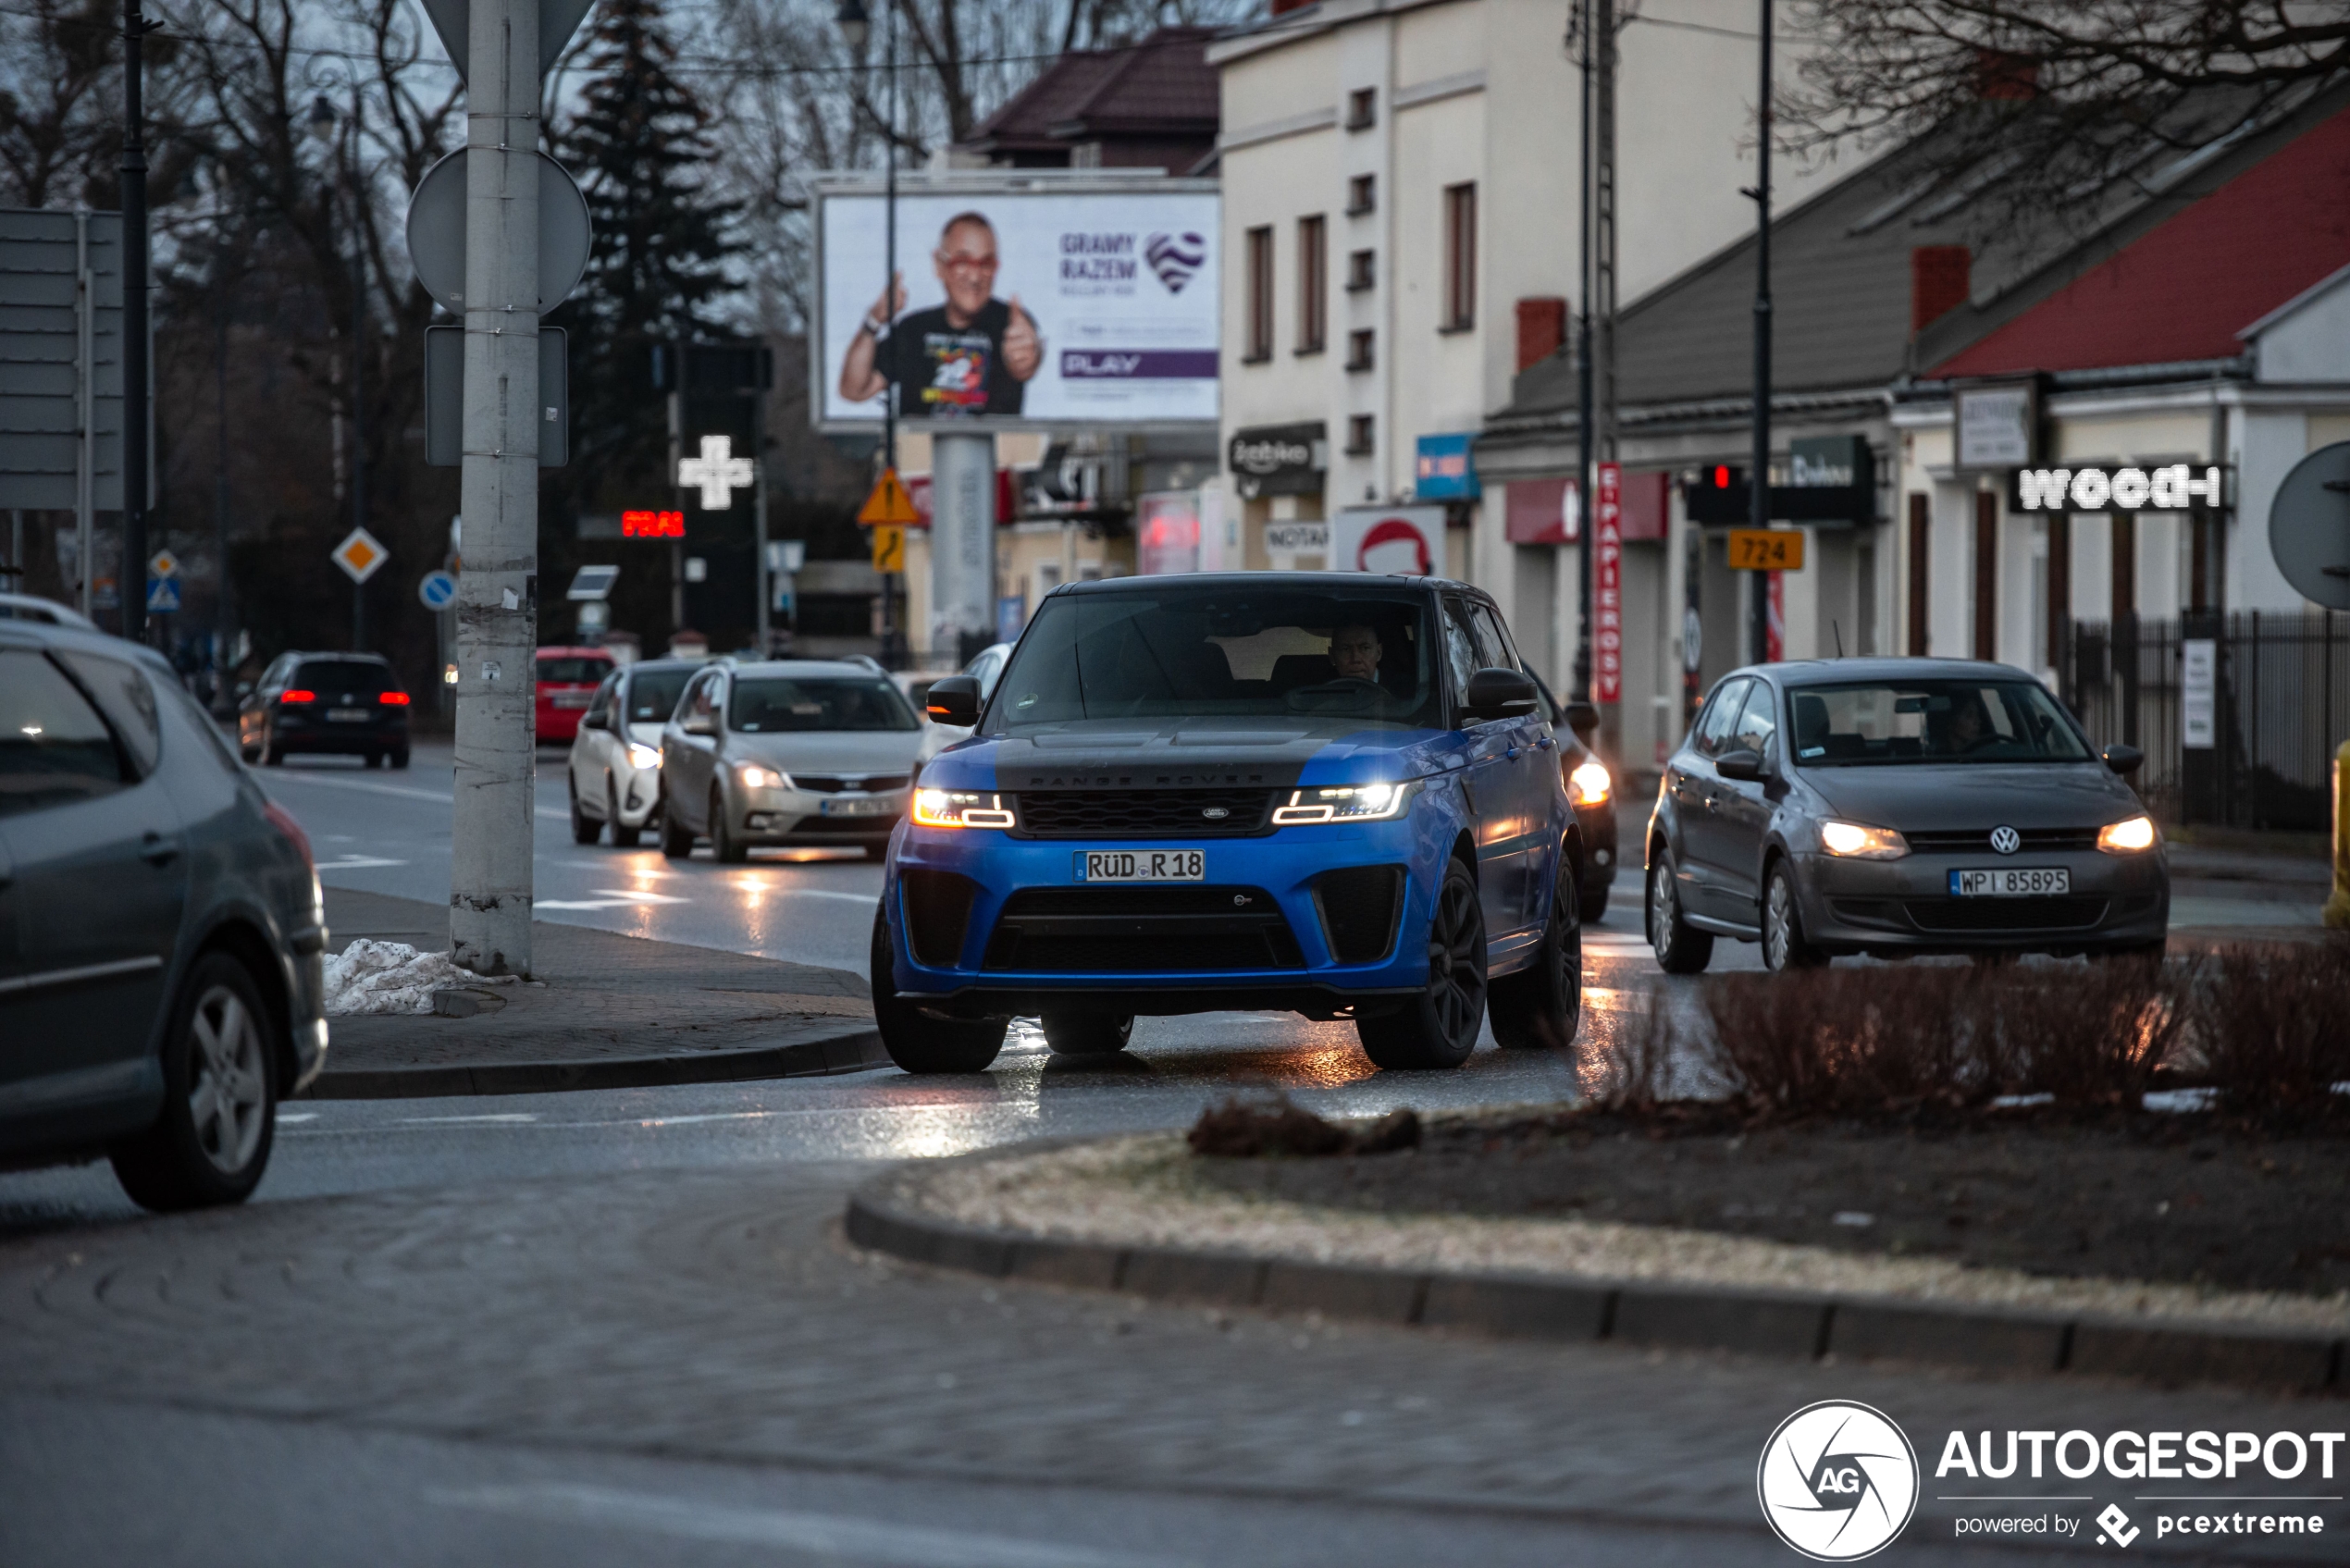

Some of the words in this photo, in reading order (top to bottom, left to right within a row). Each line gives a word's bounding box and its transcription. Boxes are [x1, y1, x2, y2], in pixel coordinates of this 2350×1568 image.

[1065, 353, 1142, 375] PLAY
[1742, 537, 1787, 562] 724
[1029, 777, 1132, 787] RANGE
[1156, 774, 1264, 785] ROVER
[1152, 854, 1167, 877] R
[1172, 853, 1202, 876] 18
[2007, 871, 2067, 892] 85895
